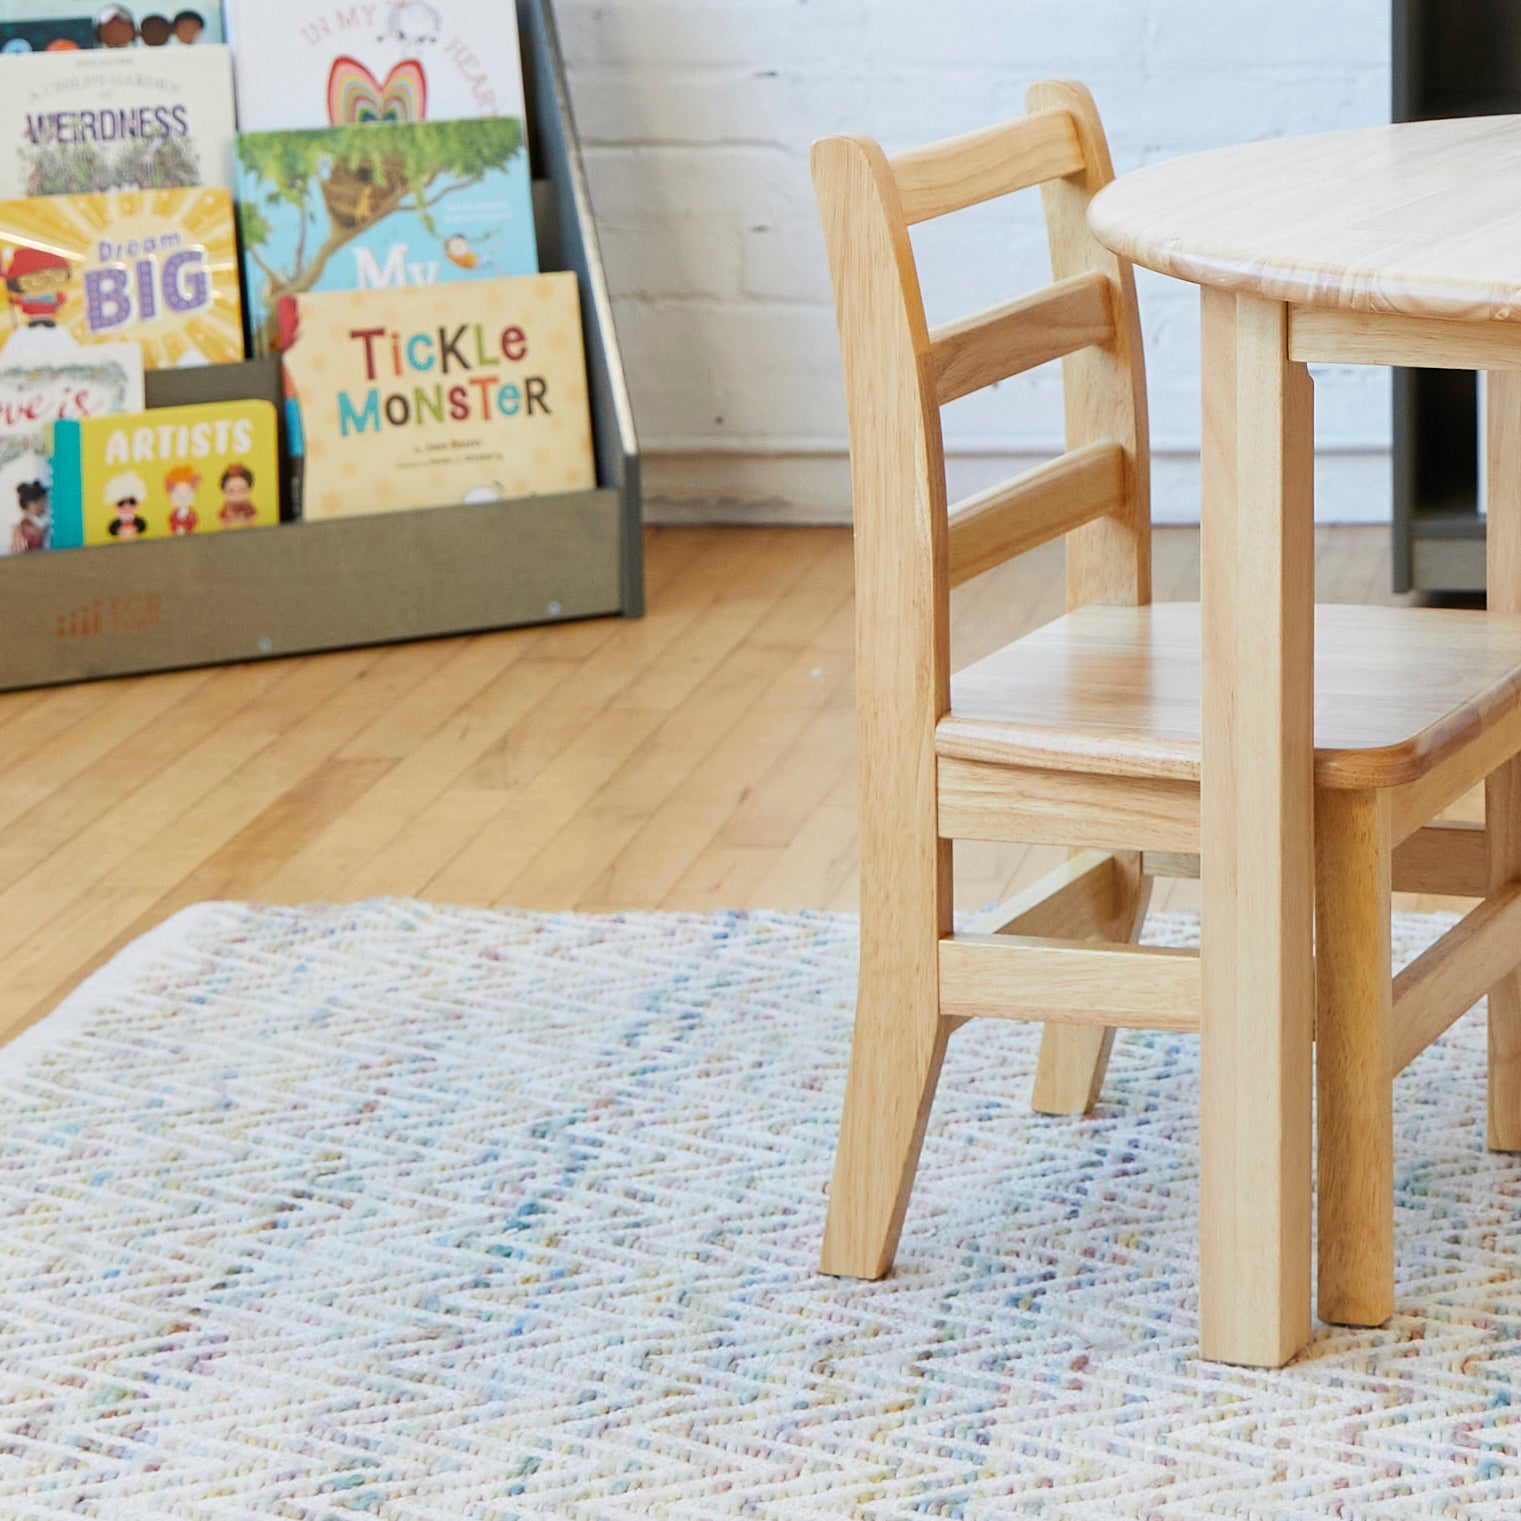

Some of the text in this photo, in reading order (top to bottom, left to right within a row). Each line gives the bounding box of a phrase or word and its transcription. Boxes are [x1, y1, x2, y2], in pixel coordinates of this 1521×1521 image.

[336, 3, 376, 30] MY
[26, 104, 189, 145] WEIRDNESS
[98, 233, 180, 263] Dream
[85, 250, 208, 333] BIG
[105, 418, 254, 465] ARTISTS
